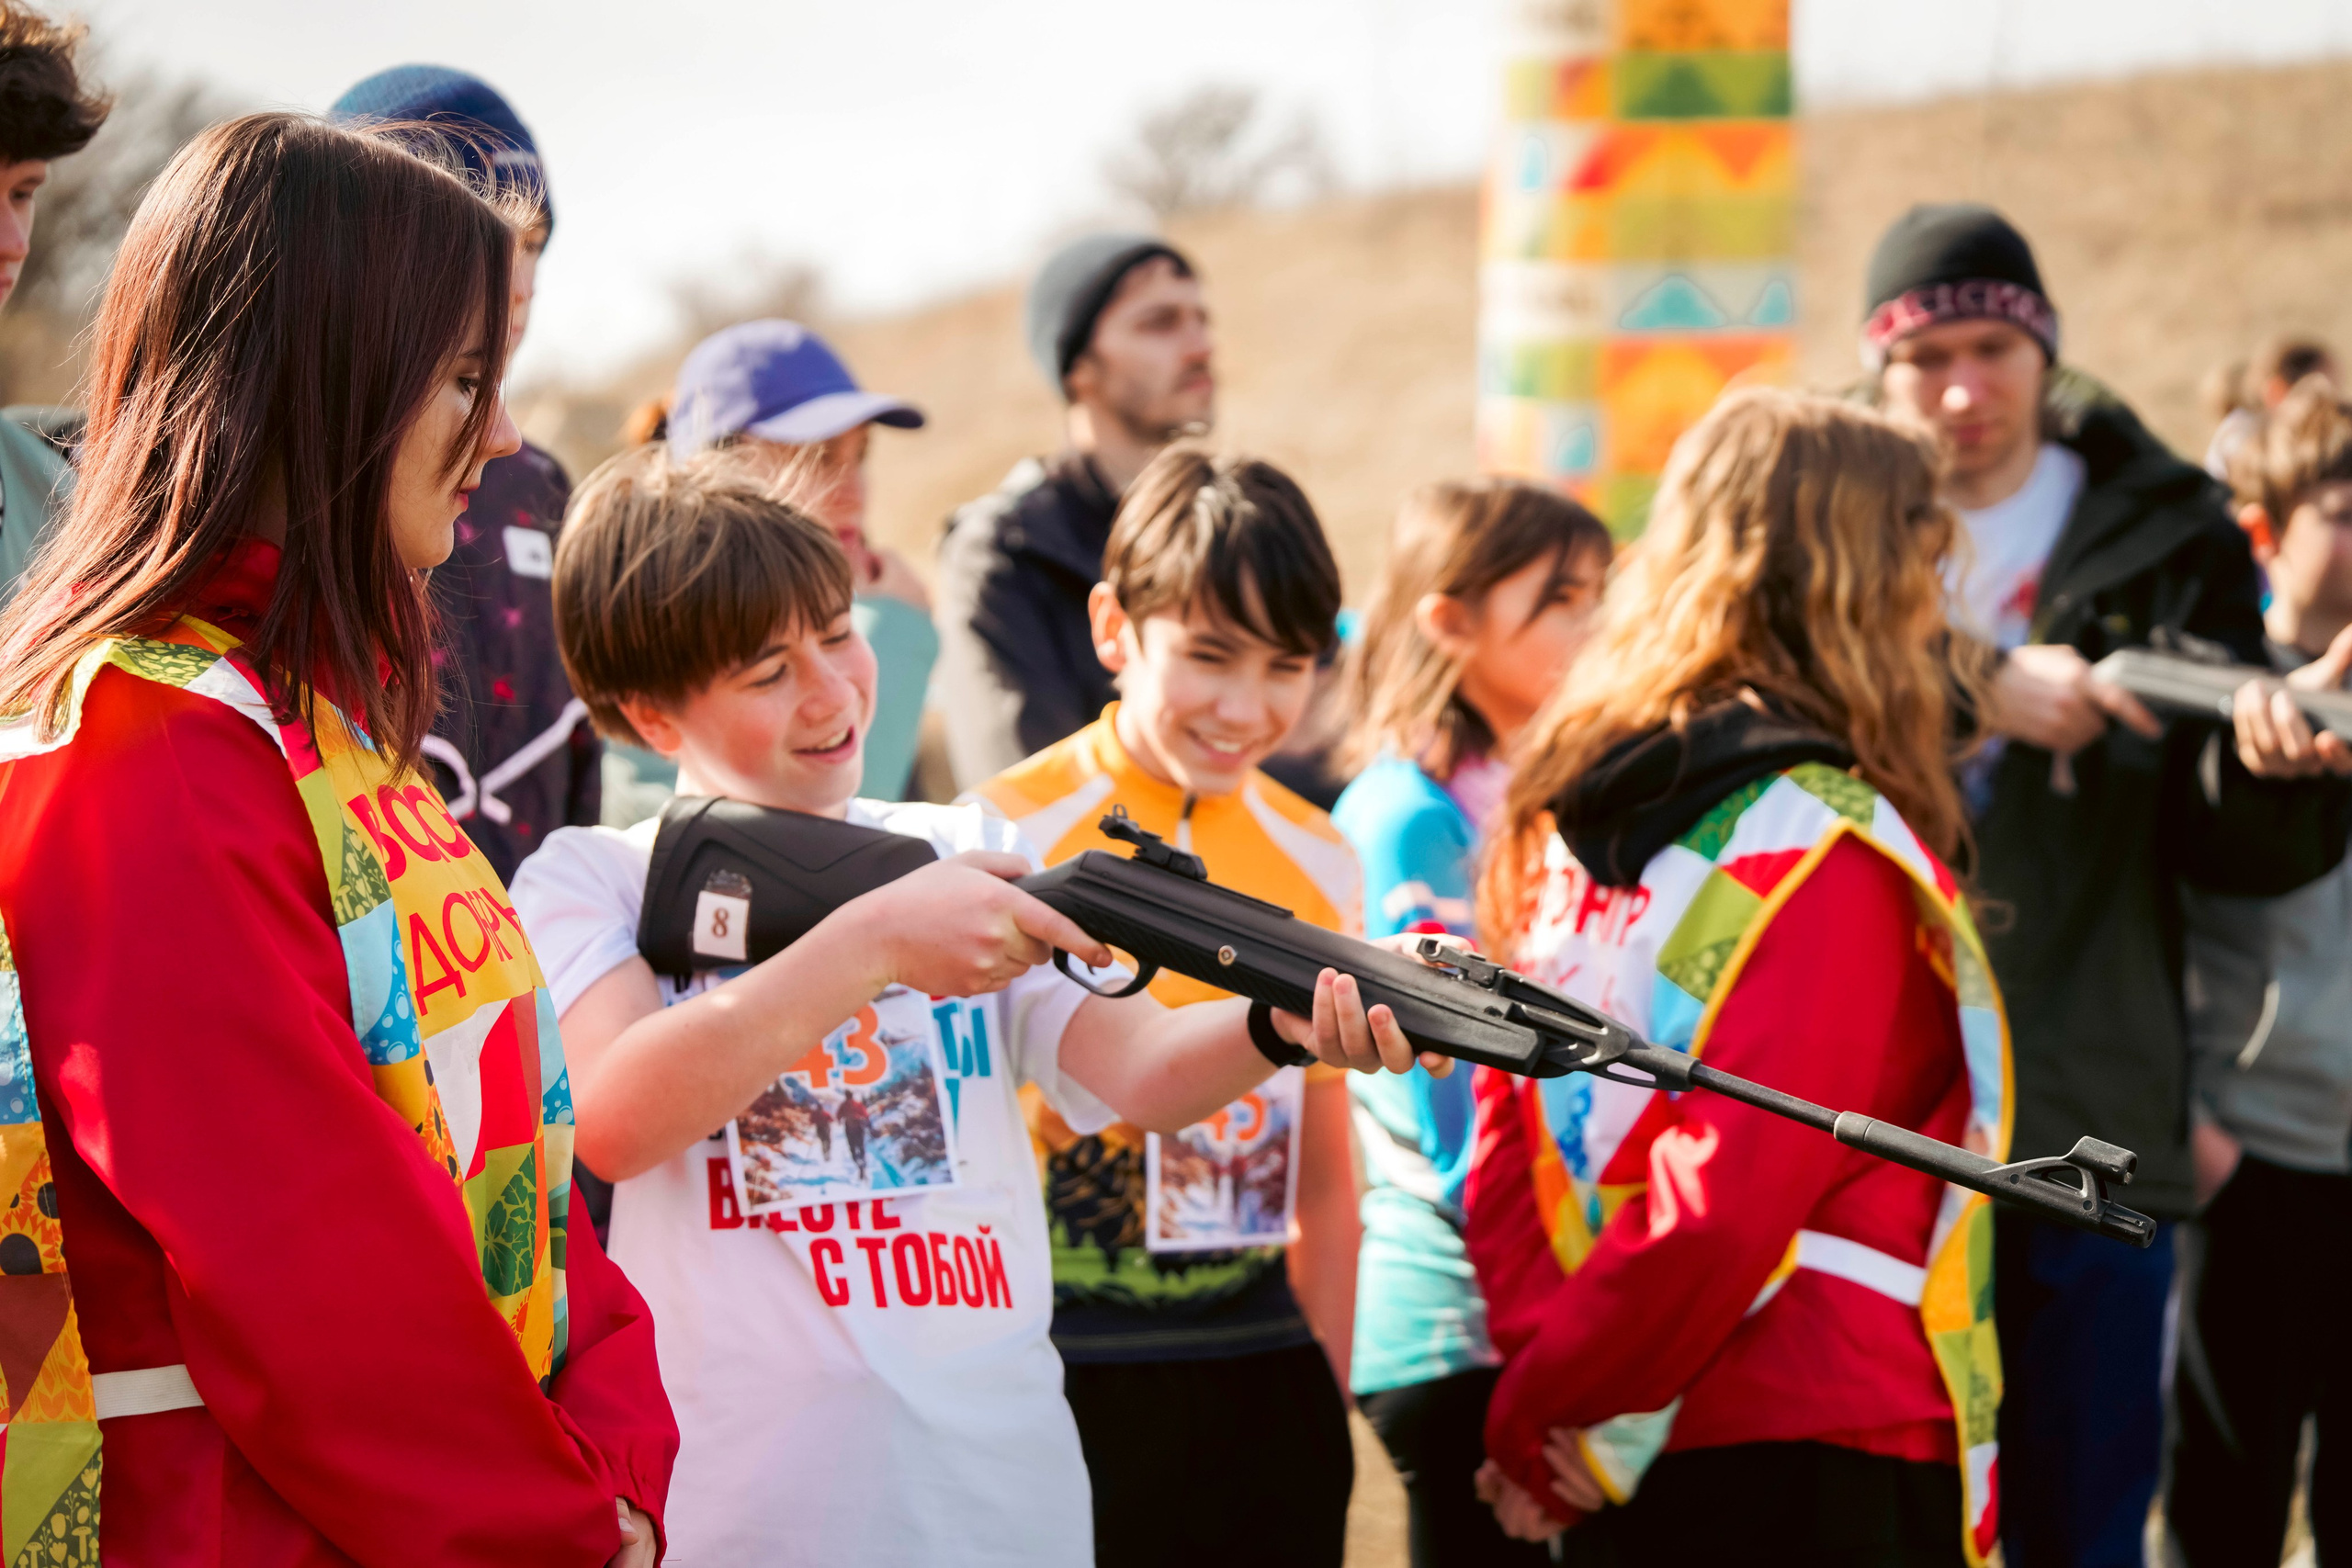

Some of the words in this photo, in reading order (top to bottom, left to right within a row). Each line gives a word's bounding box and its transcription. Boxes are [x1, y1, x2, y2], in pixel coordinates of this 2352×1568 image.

[712, 907, 729, 938] 8
[809, 1237, 850, 1307] С
[856, 1224, 1013, 1309] ТОБОЙ
